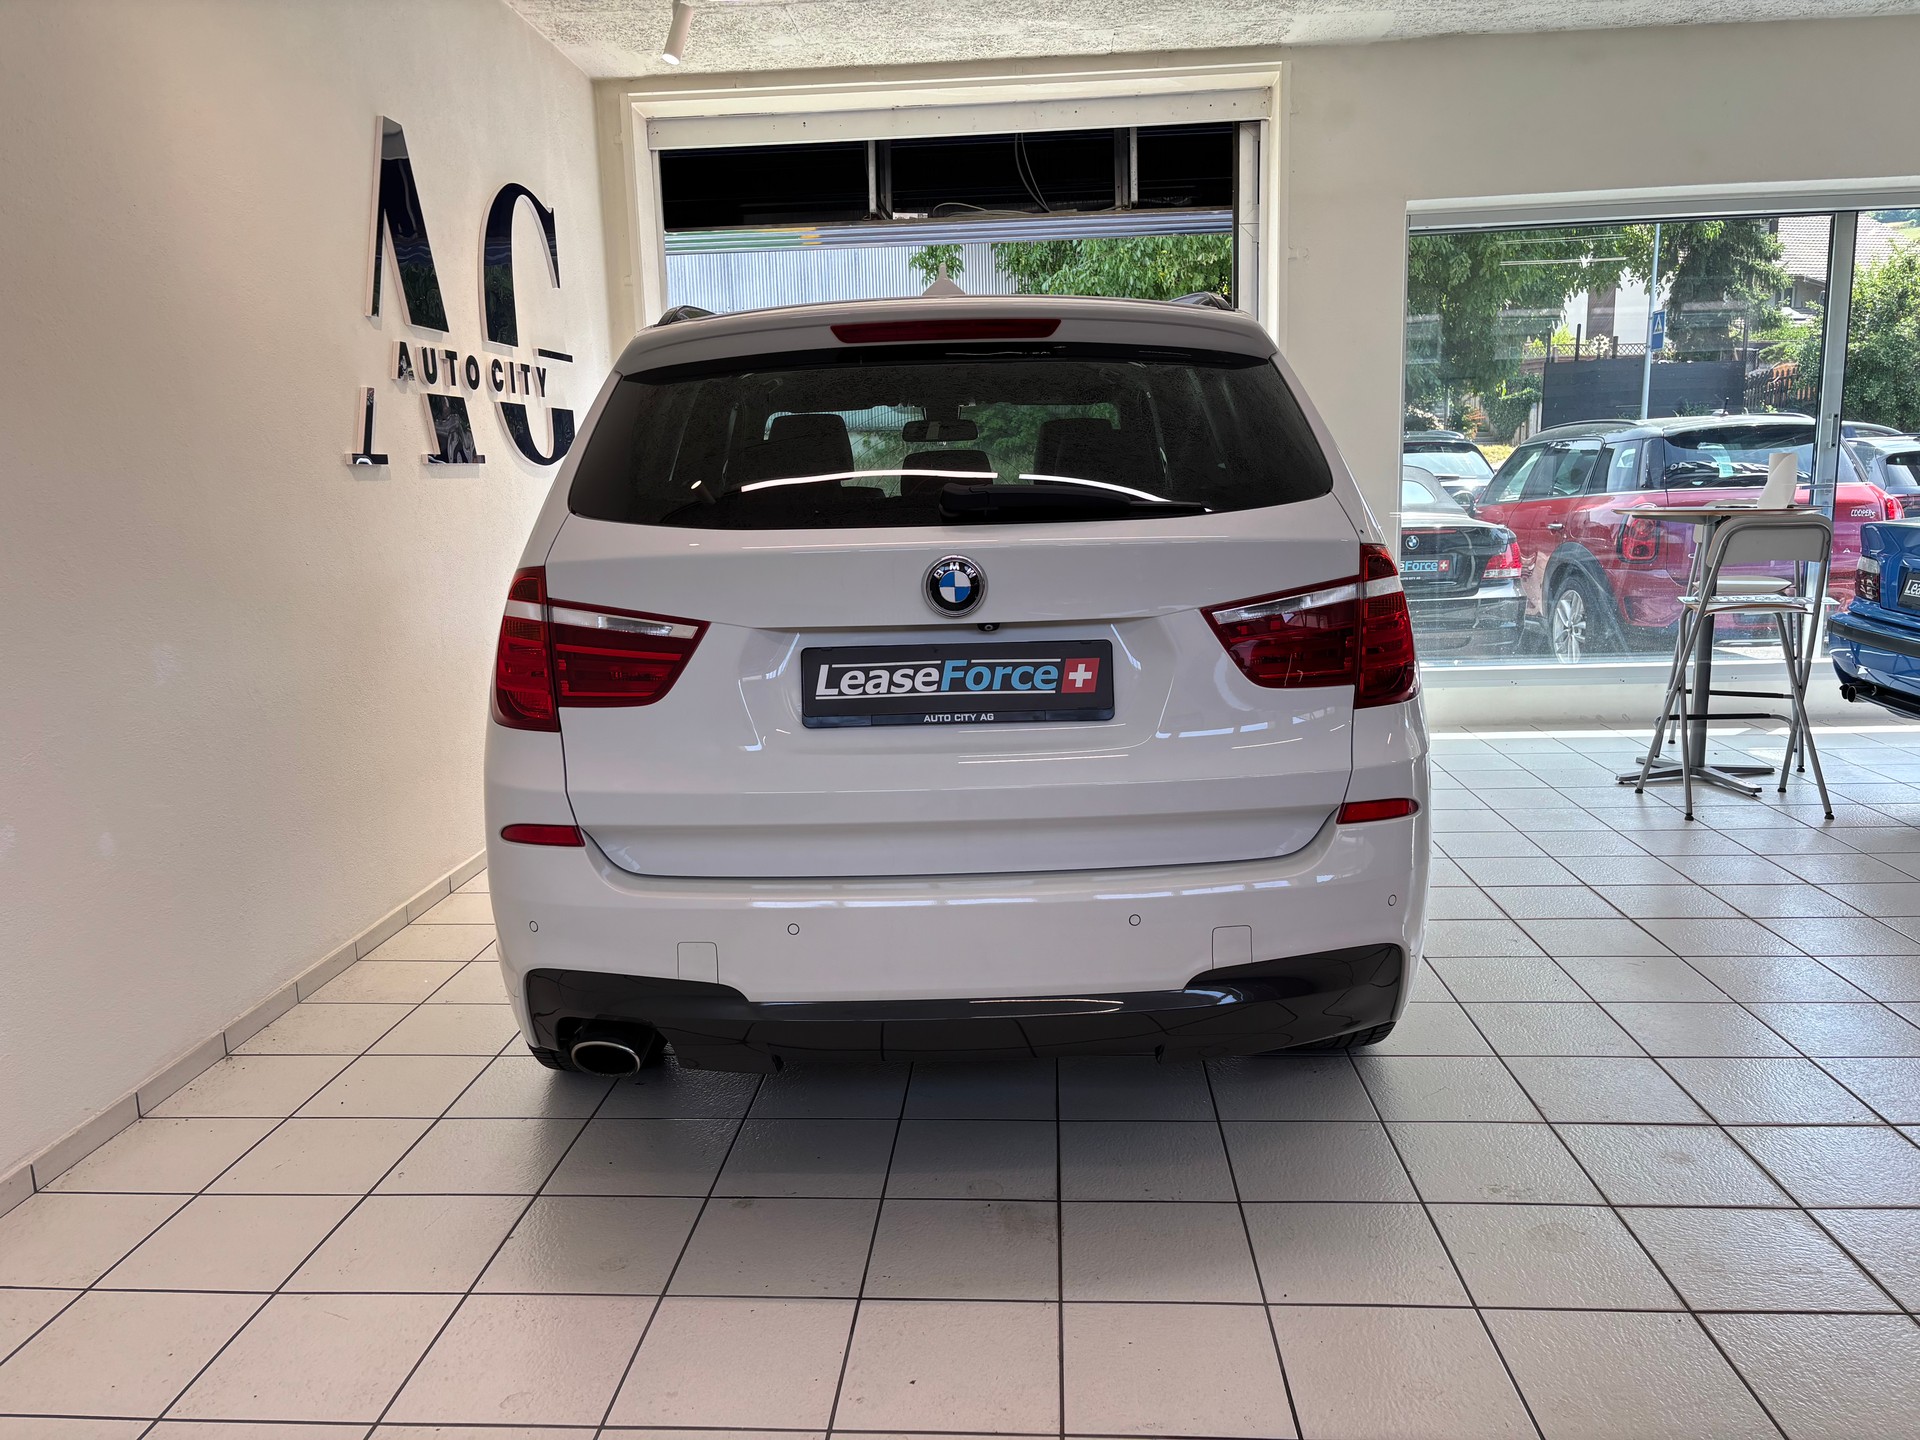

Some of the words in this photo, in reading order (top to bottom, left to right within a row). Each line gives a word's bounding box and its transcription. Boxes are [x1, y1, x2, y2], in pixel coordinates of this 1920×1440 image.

[392, 341, 480, 391] AUTO
[487, 358, 547, 397] CITY
[933, 562, 977, 579] BMW
[815, 659, 1059, 697] LeaseForce
[923, 714, 951, 723] AUTO
[954, 713, 977, 722] CITY
[980, 713, 994, 721] AG
